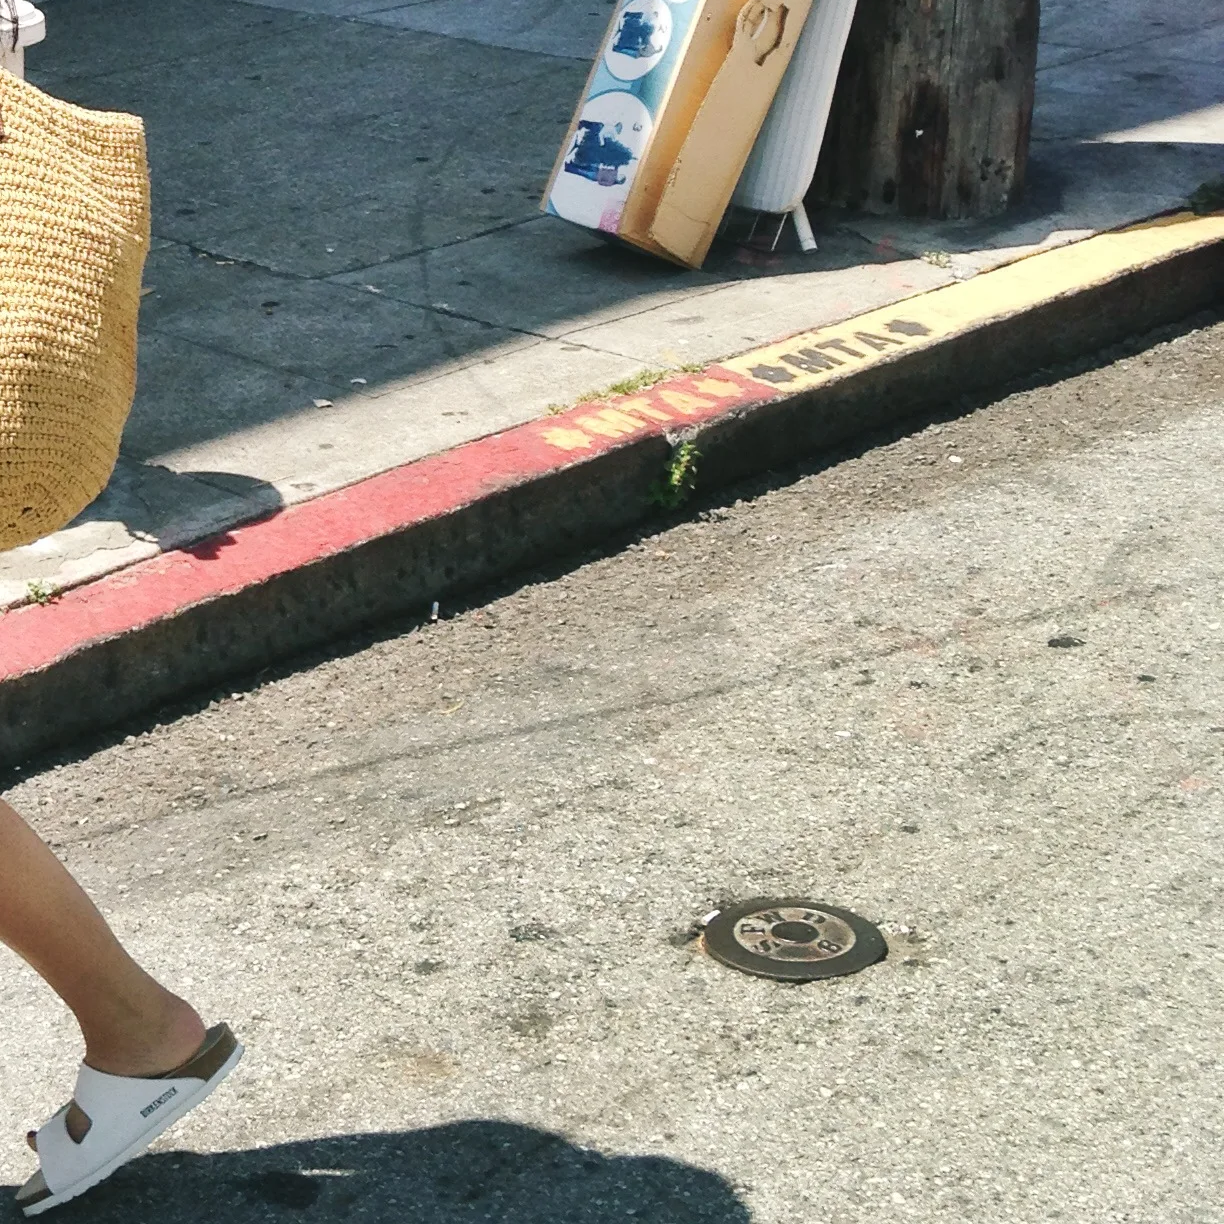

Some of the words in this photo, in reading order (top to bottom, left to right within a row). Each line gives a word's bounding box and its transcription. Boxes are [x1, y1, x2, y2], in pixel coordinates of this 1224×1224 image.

[632, 122, 643, 132] 3
[779, 330, 906, 377] MTA
[575, 388, 718, 439] MTA
